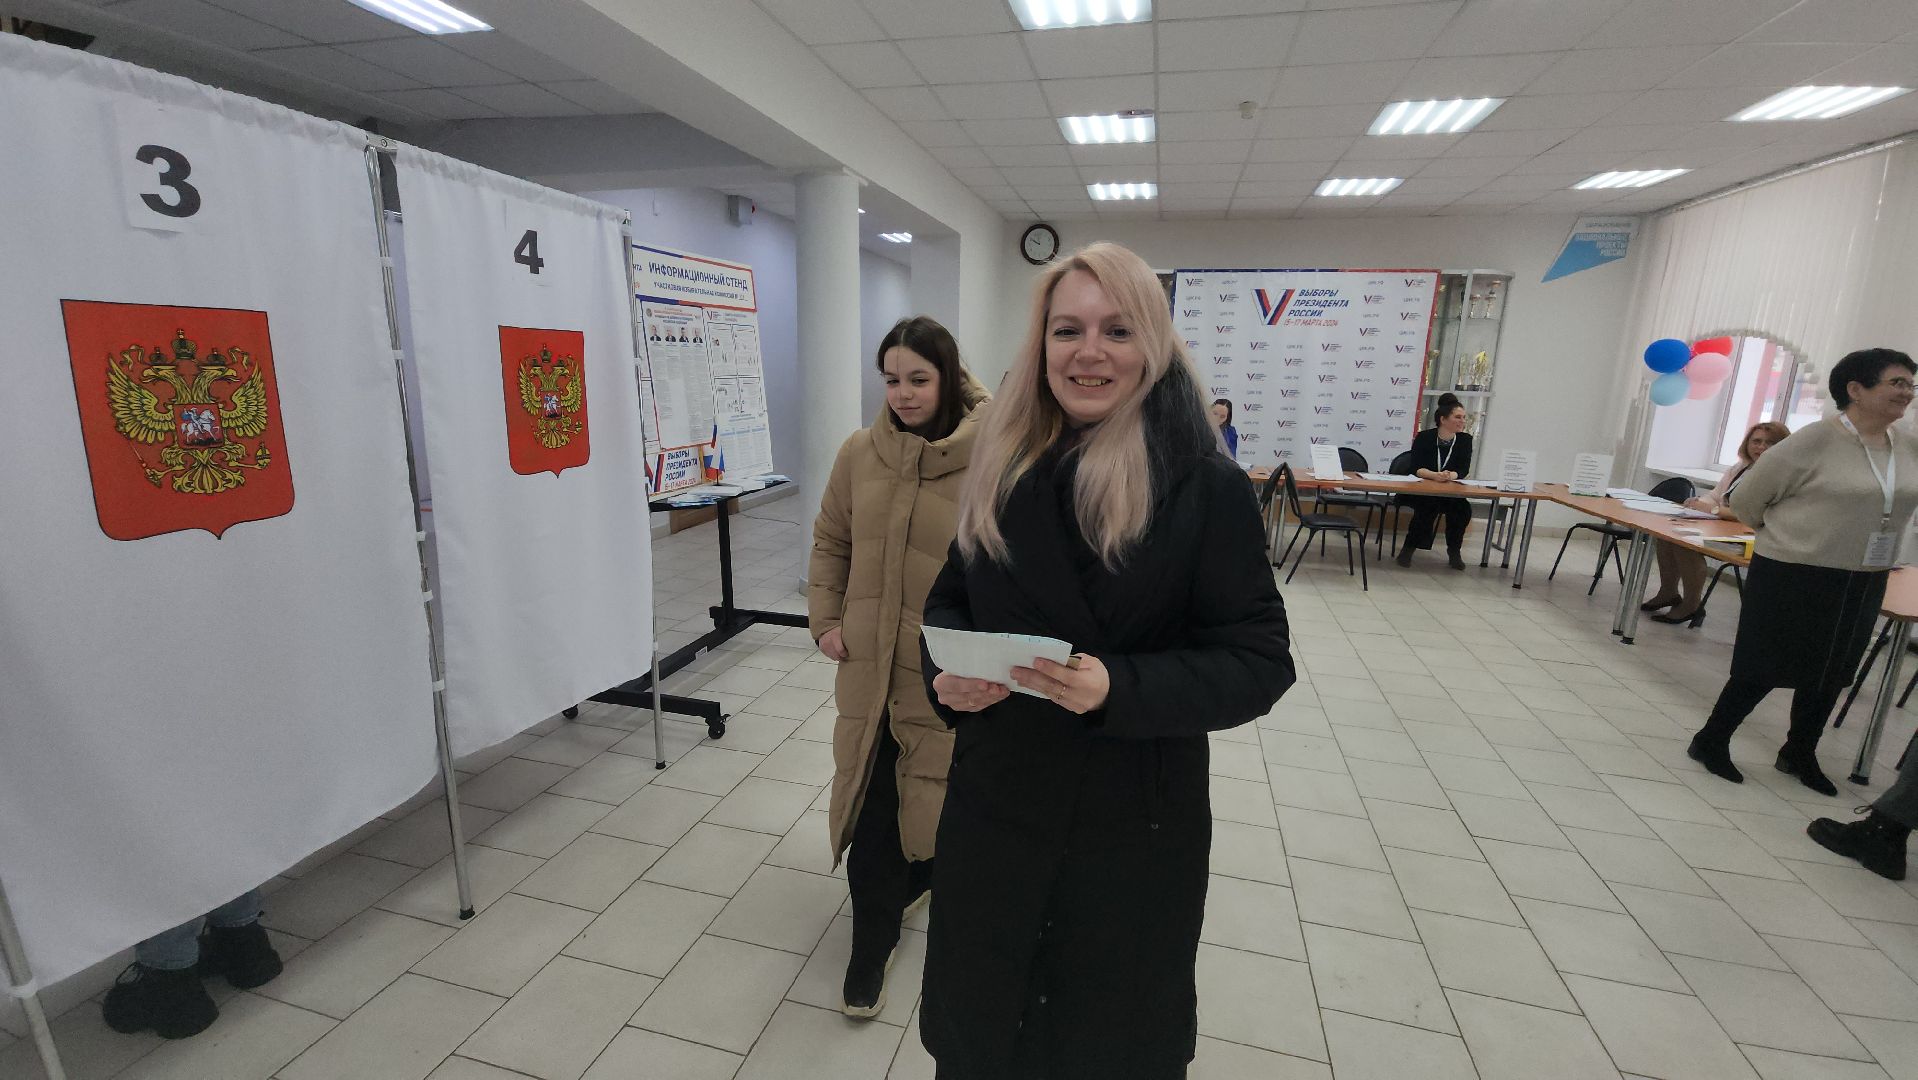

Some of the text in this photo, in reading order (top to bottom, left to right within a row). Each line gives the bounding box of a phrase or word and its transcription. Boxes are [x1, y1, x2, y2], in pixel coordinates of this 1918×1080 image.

[135, 144, 201, 218] 3
[513, 229, 544, 275] 4
[648, 261, 748, 292] ИНФОРМАЦИОННЫЙ СТЕНД
[1298, 289, 1339, 297] ВЫБОРЫ
[1292, 299, 1350, 308] ПРЕЗИДЕНТА
[1288, 309, 1323, 317] РОССИИ
[1301, 319, 1322, 327] МАРТА
[667, 449, 690, 460] ВЫБОРЫ
[665, 458, 698, 471] ПРЕЗИДЕНТА
[665, 470, 686, 481] РОССИИ
